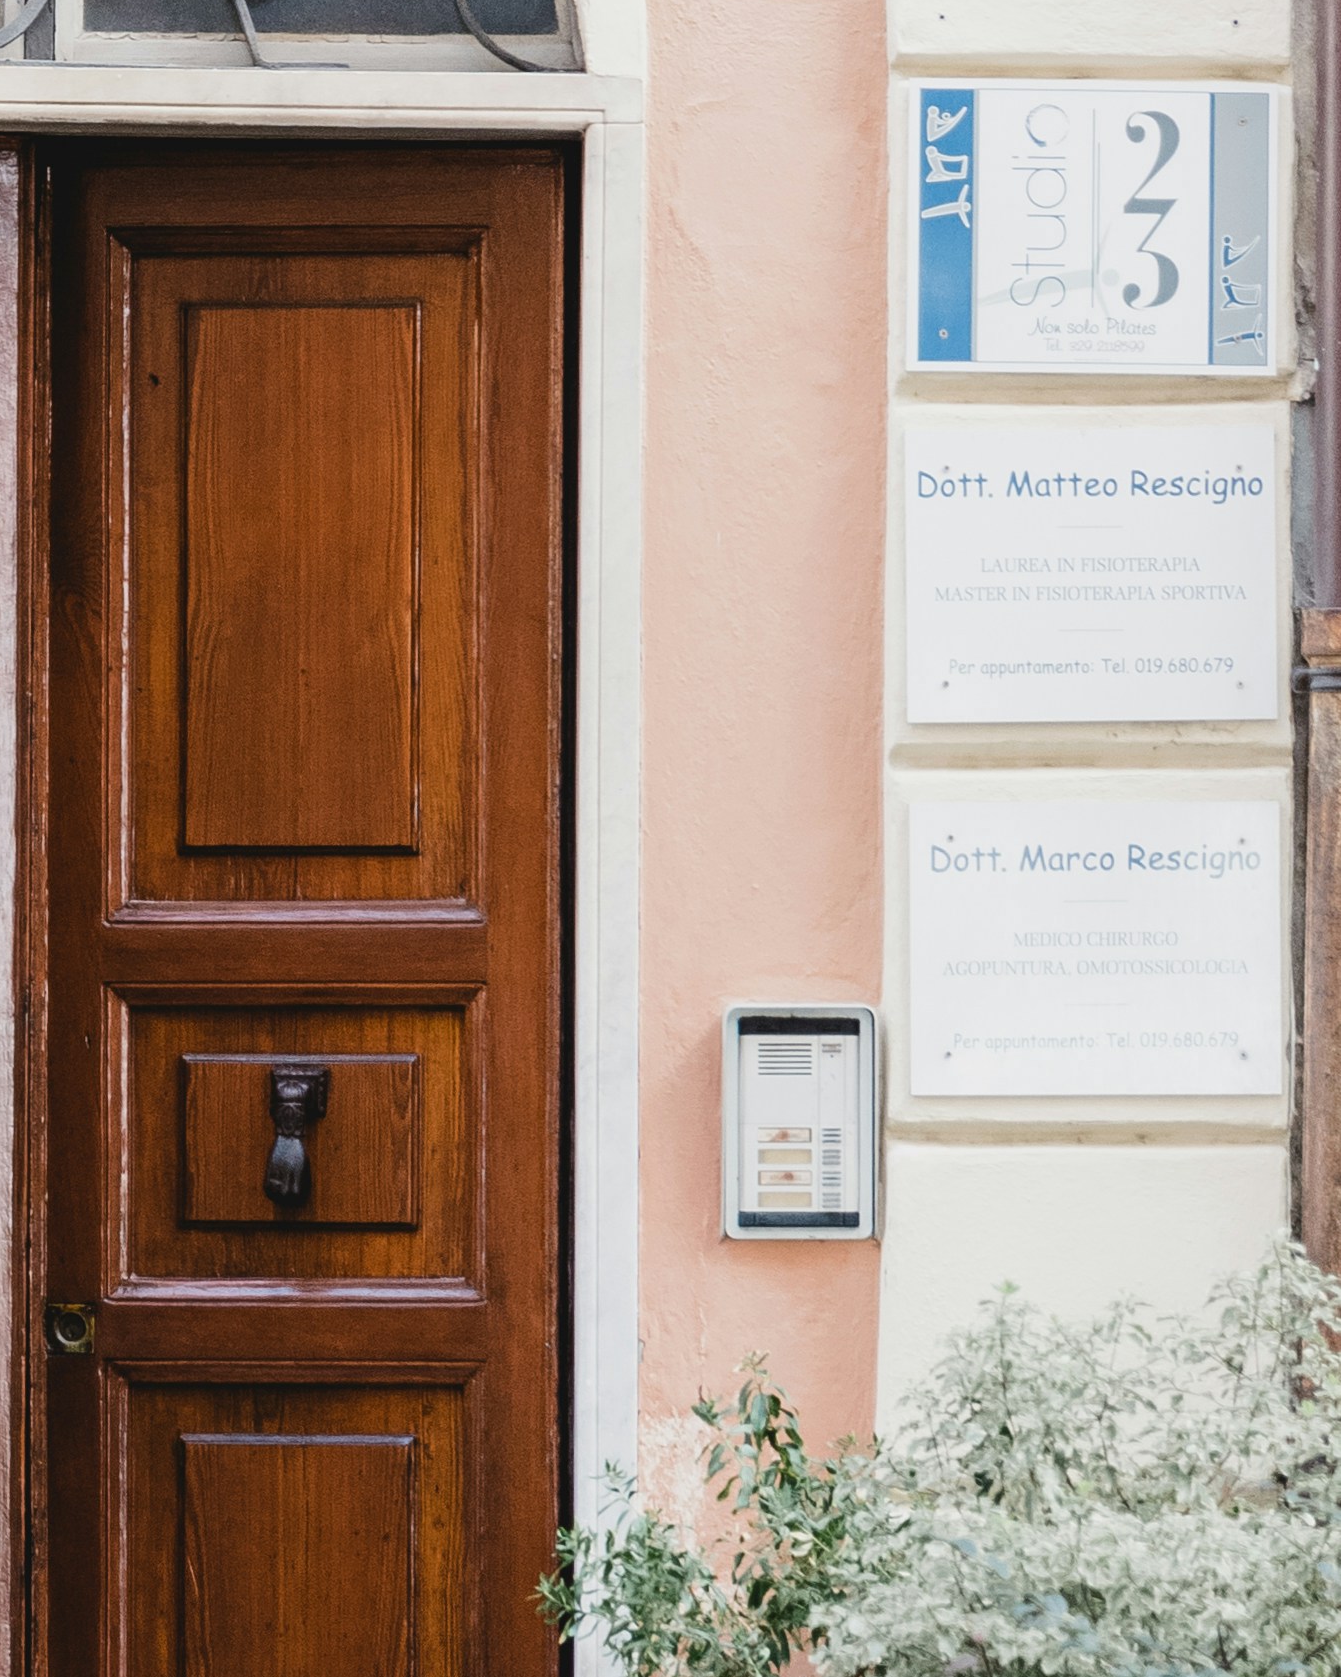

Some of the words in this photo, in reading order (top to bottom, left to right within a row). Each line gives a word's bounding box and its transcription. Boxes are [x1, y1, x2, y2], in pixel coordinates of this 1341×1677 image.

[1009, 103, 1070, 308] Studio
[1122, 110, 1180, 311] 23
[1027, 316, 1062, 336] Non
[1066, 318, 1100, 335] solo
[1105, 316, 1157, 336] Pilates
[917, 470, 994, 499] Dott.
[1005, 469, 1119, 498] Matteo
[1130, 469, 1264, 505] Rescigno
[979, 557, 1052, 574] LAUREA
[1056, 557, 1076, 573] IN
[1080, 556, 1202, 573] FISIOTERAPIA
[934, 586, 1007, 603] MASTER
[1012, 585, 1031, 602] IN
[1035, 585, 1156, 602] FISIOTERAPIA
[1160, 584, 1248, 601] SPORTIVA
[948, 658, 974, 675] Per
[979, 658, 1095, 679] appuntamento:
[1101, 657, 1130, 674] Tel.
[1134, 656, 1235, 675] 019.680.679
[930, 844, 1008, 873] Dott.
[1019, 844, 1116, 872] Marco
[1127, 842, 1262, 879] Rescigno
[1013, 931, 1082, 947] MEDICO
[1085, 930, 1179, 947] CHIRURGO
[1075, 958, 1250, 975] OMOTOSSICOLOGIA
[953, 1032, 981, 1049] Per
[984, 1031, 1100, 1054] appuntamento:
[1106, 1031, 1133, 1049] Tel.
[1139, 1030, 1240, 1049] 019.680.679
